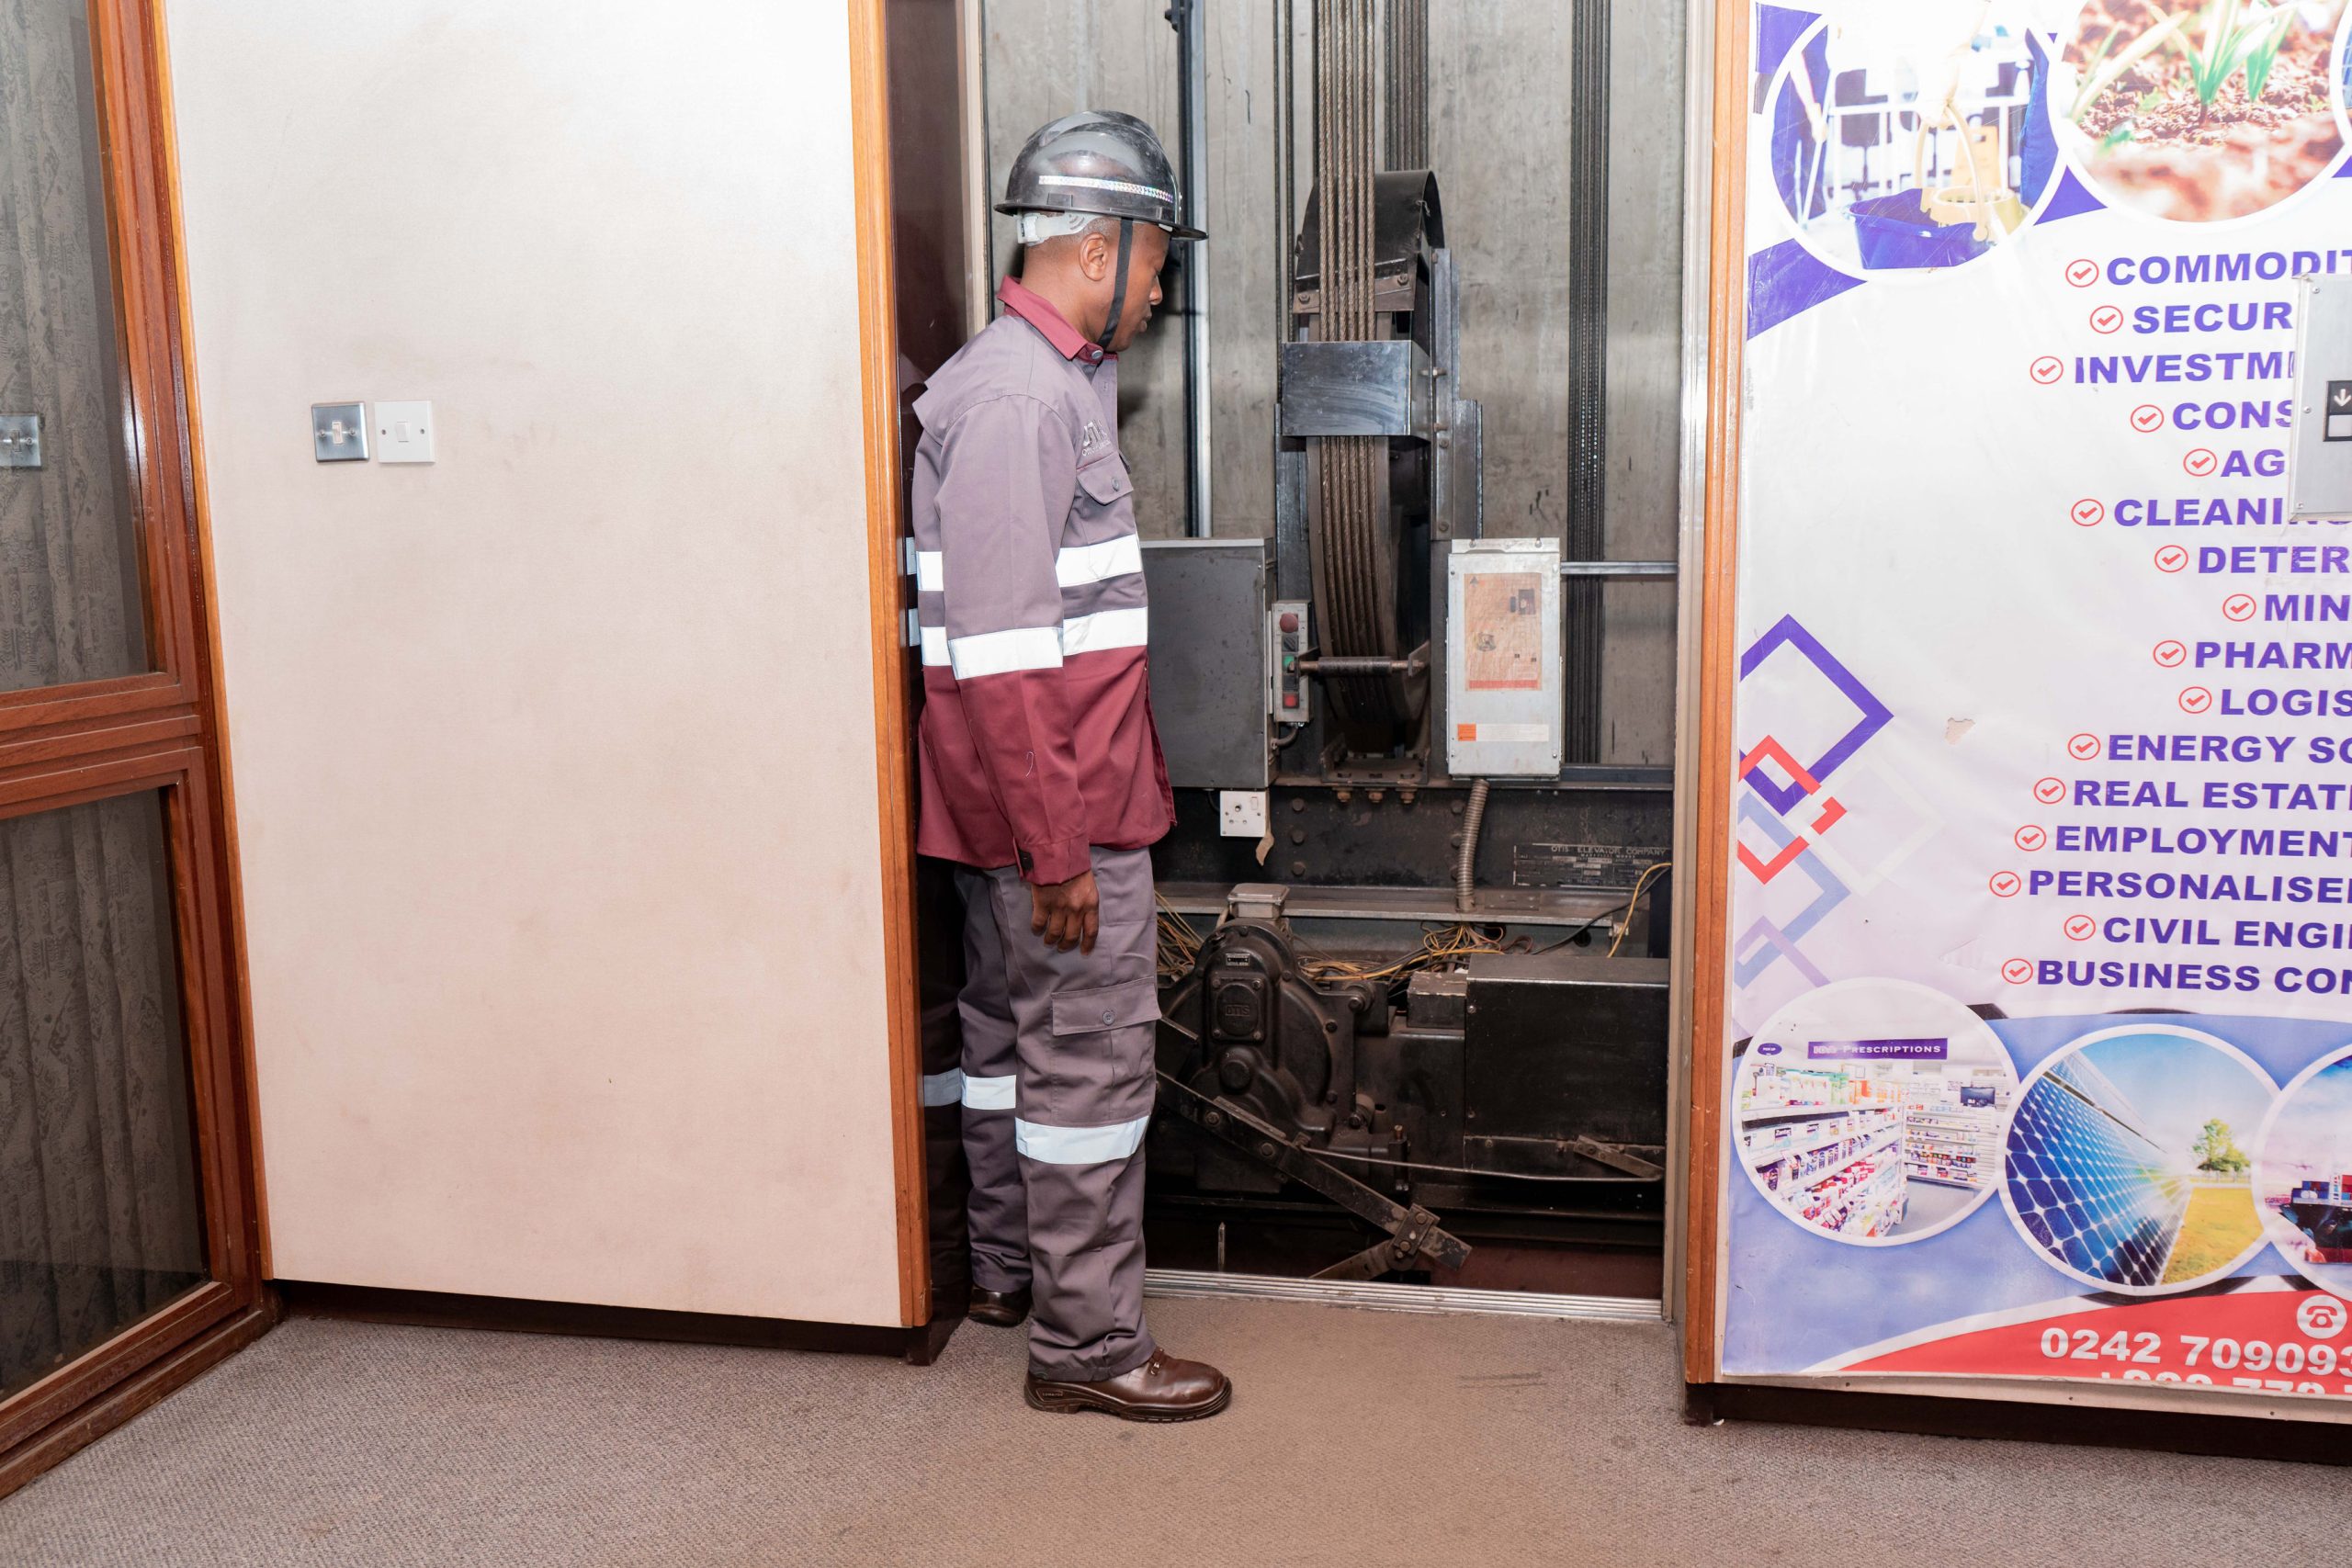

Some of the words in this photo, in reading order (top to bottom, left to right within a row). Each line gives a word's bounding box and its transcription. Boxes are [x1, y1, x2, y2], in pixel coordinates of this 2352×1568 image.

[2132, 301, 2292, 333] SECUR
[2075, 352, 2294, 384] INVESTM
[2221, 449, 2285, 478] AG
[2115, 498, 2352, 526] CLEANI
[2199, 547, 2348, 573] DETER
[2265, 595, 2349, 621] MIN
[2196, 642, 2352, 669] PHARM
[2221, 689, 2352, 716] LOGIS
[2109, 735, 2294, 761] ENERGY
[2075, 781, 2188, 807] REAL
[2203, 783, 2352, 810] ESTAT
[2030, 871, 2352, 903] PERSONALISE
[2104, 918, 2220, 944] CIVIL
[2234, 921, 2352, 949] ENGI
[2038, 961, 2259, 991] BUSINESS
[1226, 1004, 1250, 1016] OTIS
[2041, 1327, 2162, 1364] 0242
